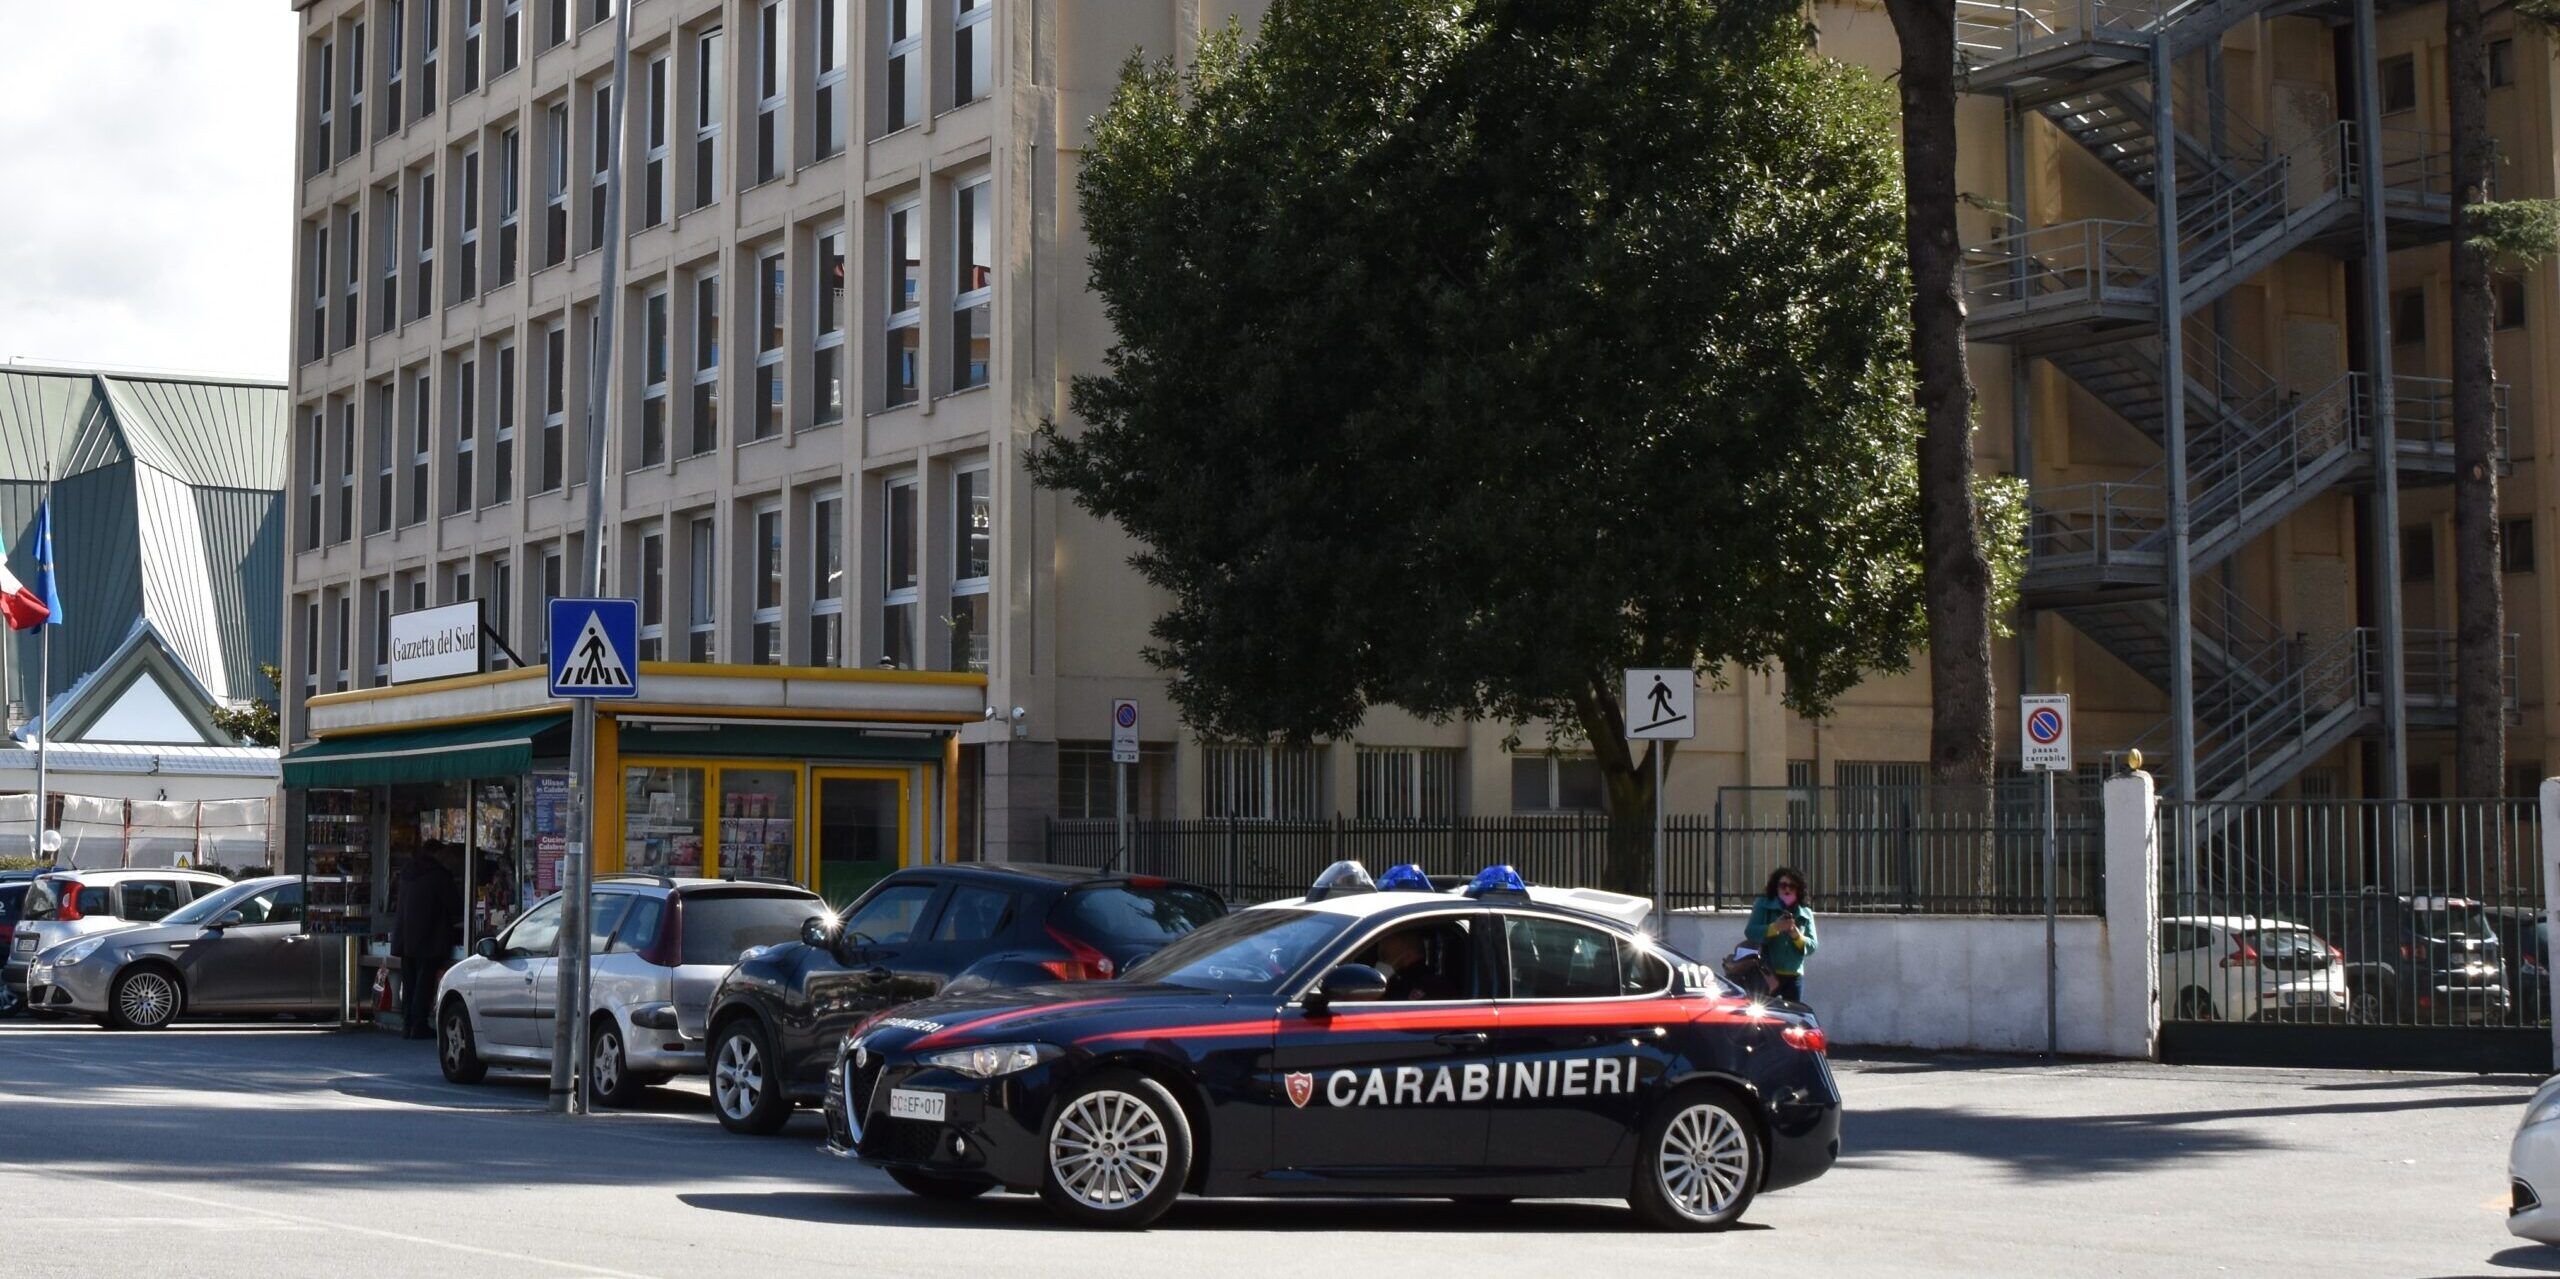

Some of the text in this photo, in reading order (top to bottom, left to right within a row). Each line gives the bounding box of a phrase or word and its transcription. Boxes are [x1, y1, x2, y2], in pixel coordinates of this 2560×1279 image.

[393, 624, 476, 662] Gazzetta del Sud
[2025, 754, 2066, 762] carrabile
[2032, 747, 2059, 755] passo
[1677, 963, 1716, 988] 112
[1326, 1056, 1637, 1108] CARABINIERI
